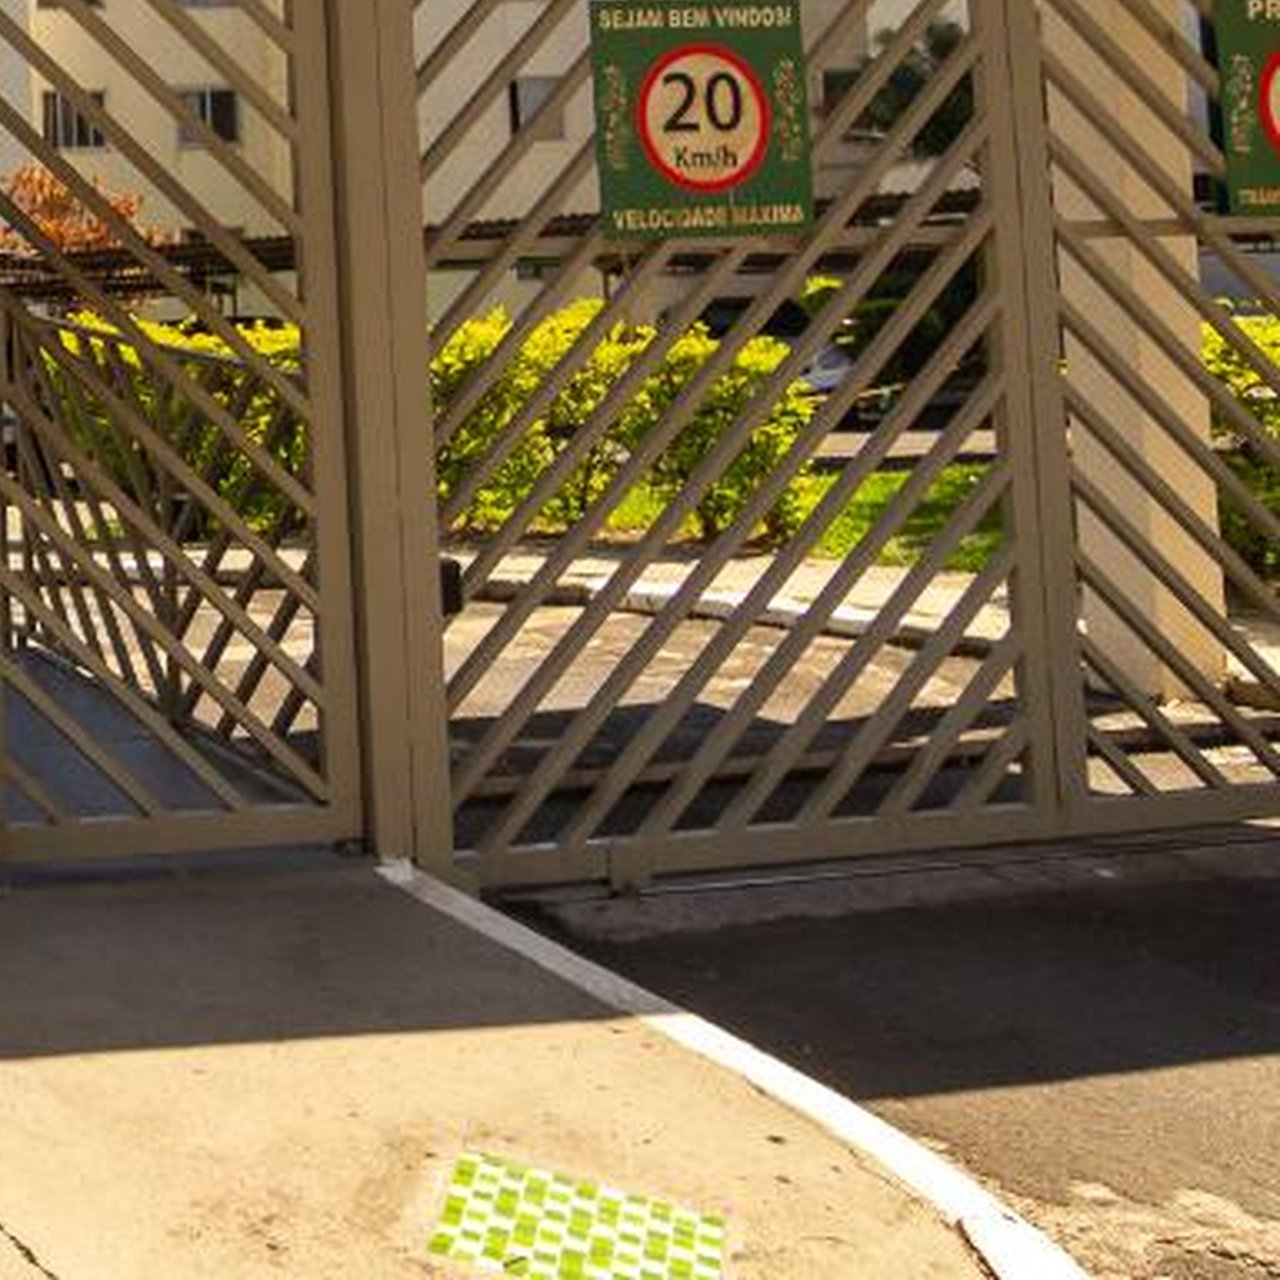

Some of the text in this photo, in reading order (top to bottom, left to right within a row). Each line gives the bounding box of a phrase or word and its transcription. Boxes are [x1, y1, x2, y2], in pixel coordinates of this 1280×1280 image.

[599, 8, 663, 30] SEJAM
[668, 8, 710, 28] BEM
[661, 72, 742, 132] 20
